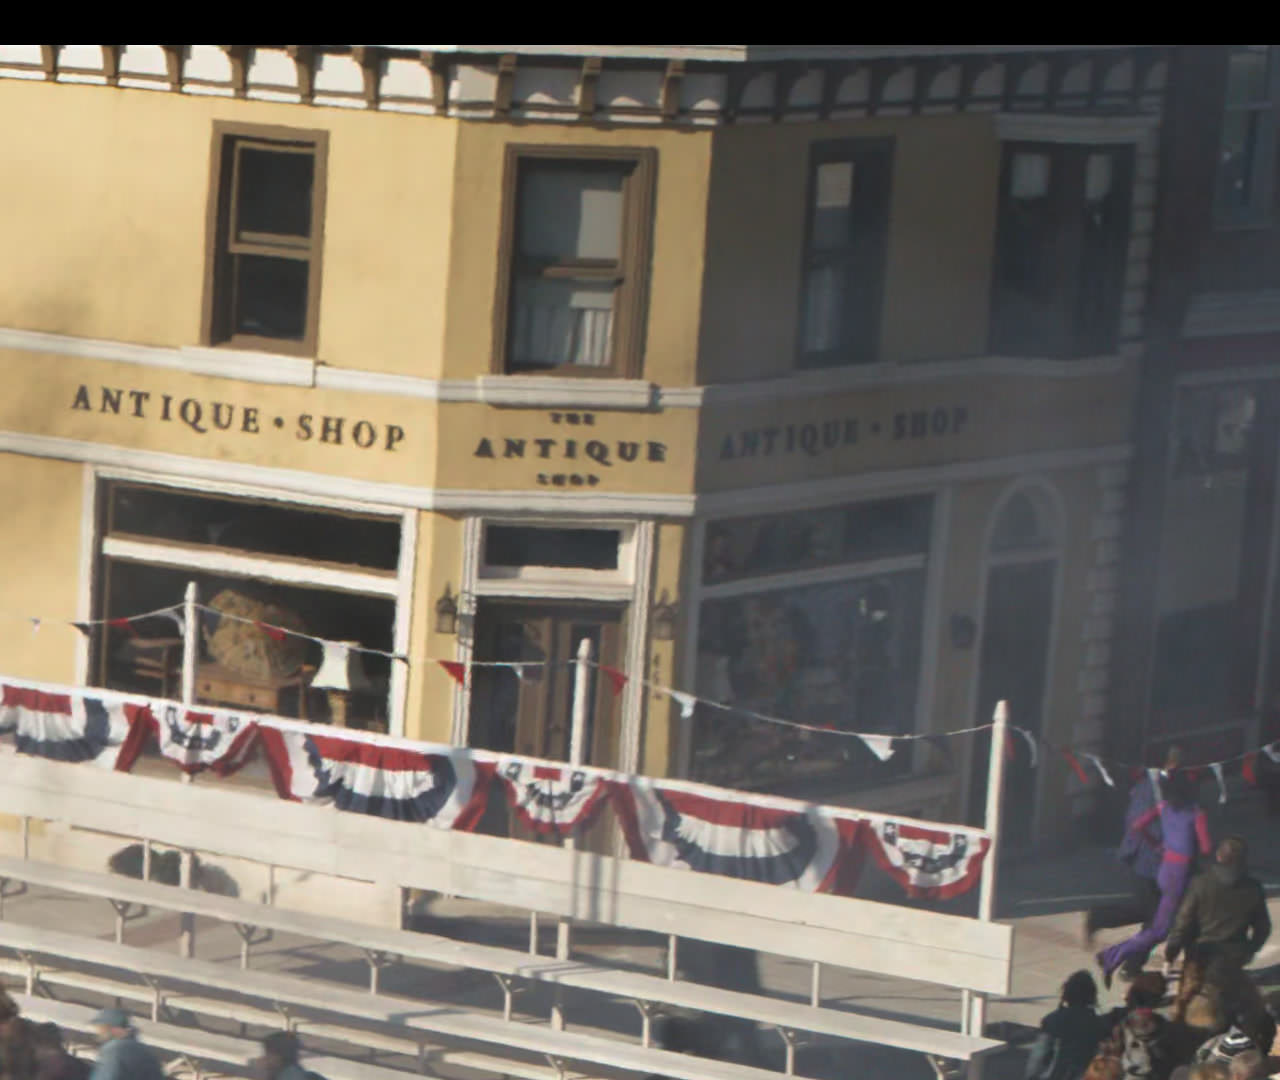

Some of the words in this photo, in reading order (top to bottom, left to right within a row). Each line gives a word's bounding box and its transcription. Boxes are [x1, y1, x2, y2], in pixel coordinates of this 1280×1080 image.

[71, 384, 261, 434] ANTIQUE
[295, 413, 406, 453] SHOP
[719, 418, 860, 461] ANTIQUE
[892, 407, 970, 441] SHOP
[473, 437, 668, 467] ANTIQUE
